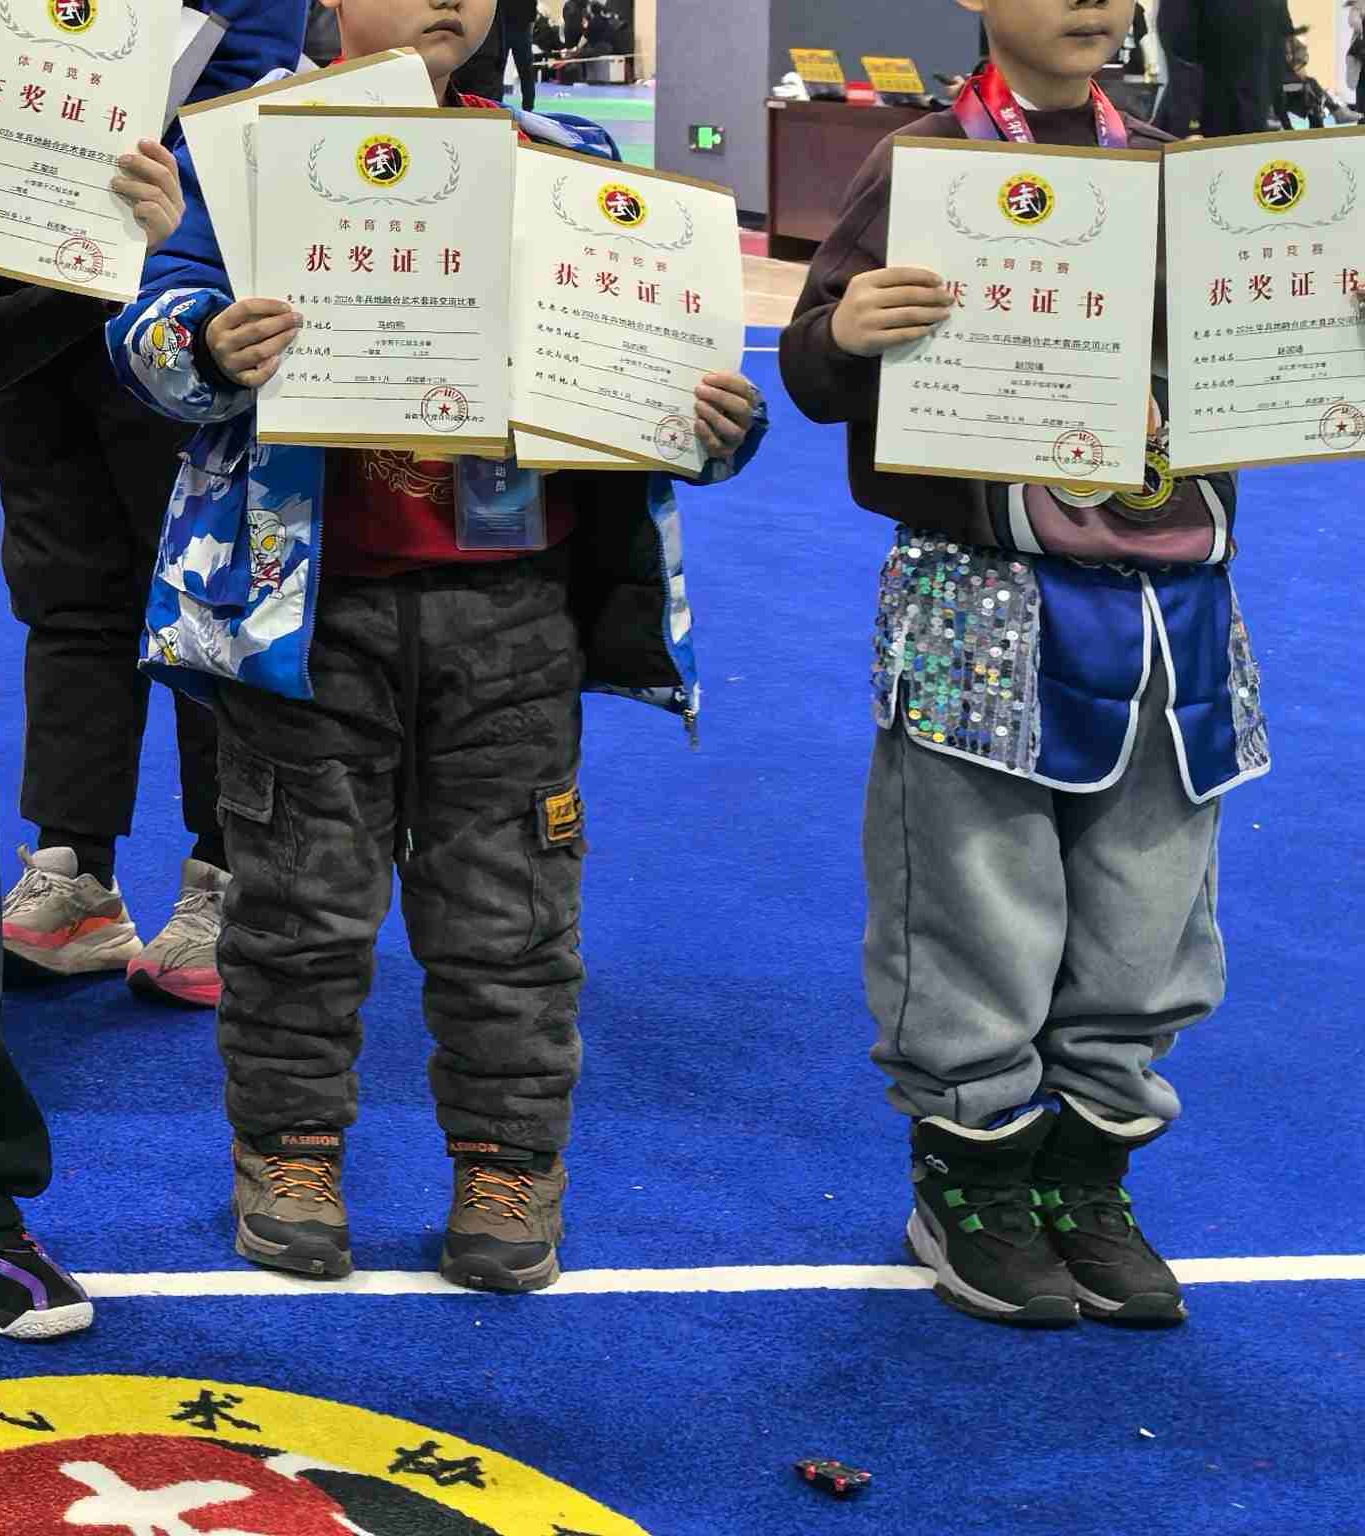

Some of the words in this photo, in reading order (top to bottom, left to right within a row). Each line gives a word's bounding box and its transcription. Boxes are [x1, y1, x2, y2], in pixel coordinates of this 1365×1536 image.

[339, 218, 427, 233] 体育竞赛
[305, 244, 462, 276] 获奖证书
[975, 257, 1070, 275] 体育竞赛
[554, 263, 701, 315] 获奖证书
[1208, 268, 1358, 306] 获奖证书
[945, 280, 1106, 320] 获奖证书
[280, 1135, 339, 1146] FASHION
[450, 1142, 501, 1153] ASHION
